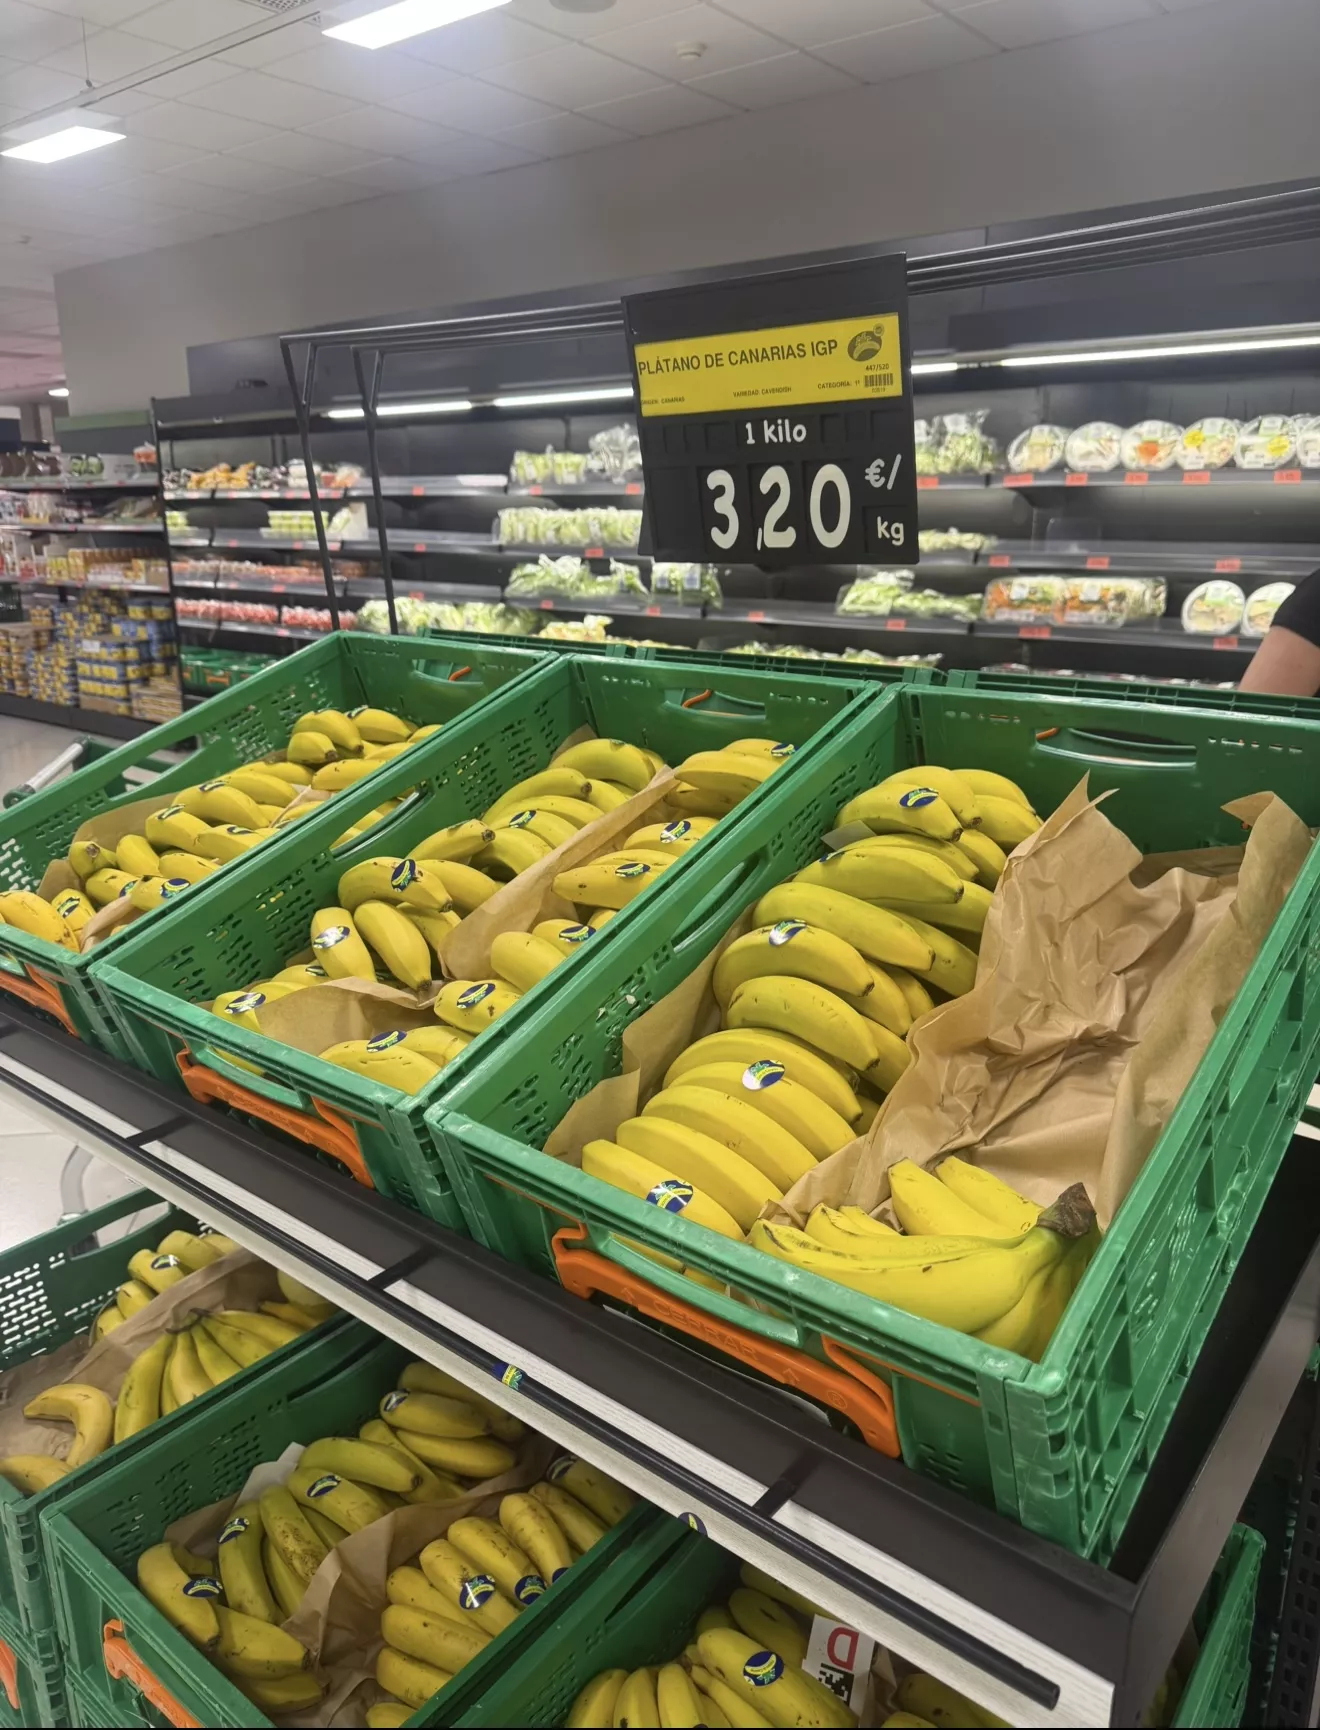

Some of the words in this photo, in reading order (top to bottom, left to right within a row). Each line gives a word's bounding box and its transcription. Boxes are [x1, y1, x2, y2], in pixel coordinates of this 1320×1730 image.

[638, 355, 701, 375] PLÁTANO
[704, 352, 725, 369] DE
[728, 343, 807, 366] CANARIAS
[811, 339, 838, 357] IGP
[745, 421, 756, 445] 1
[763, 418, 807, 444] kilo
[876, 516, 905, 546] kg
